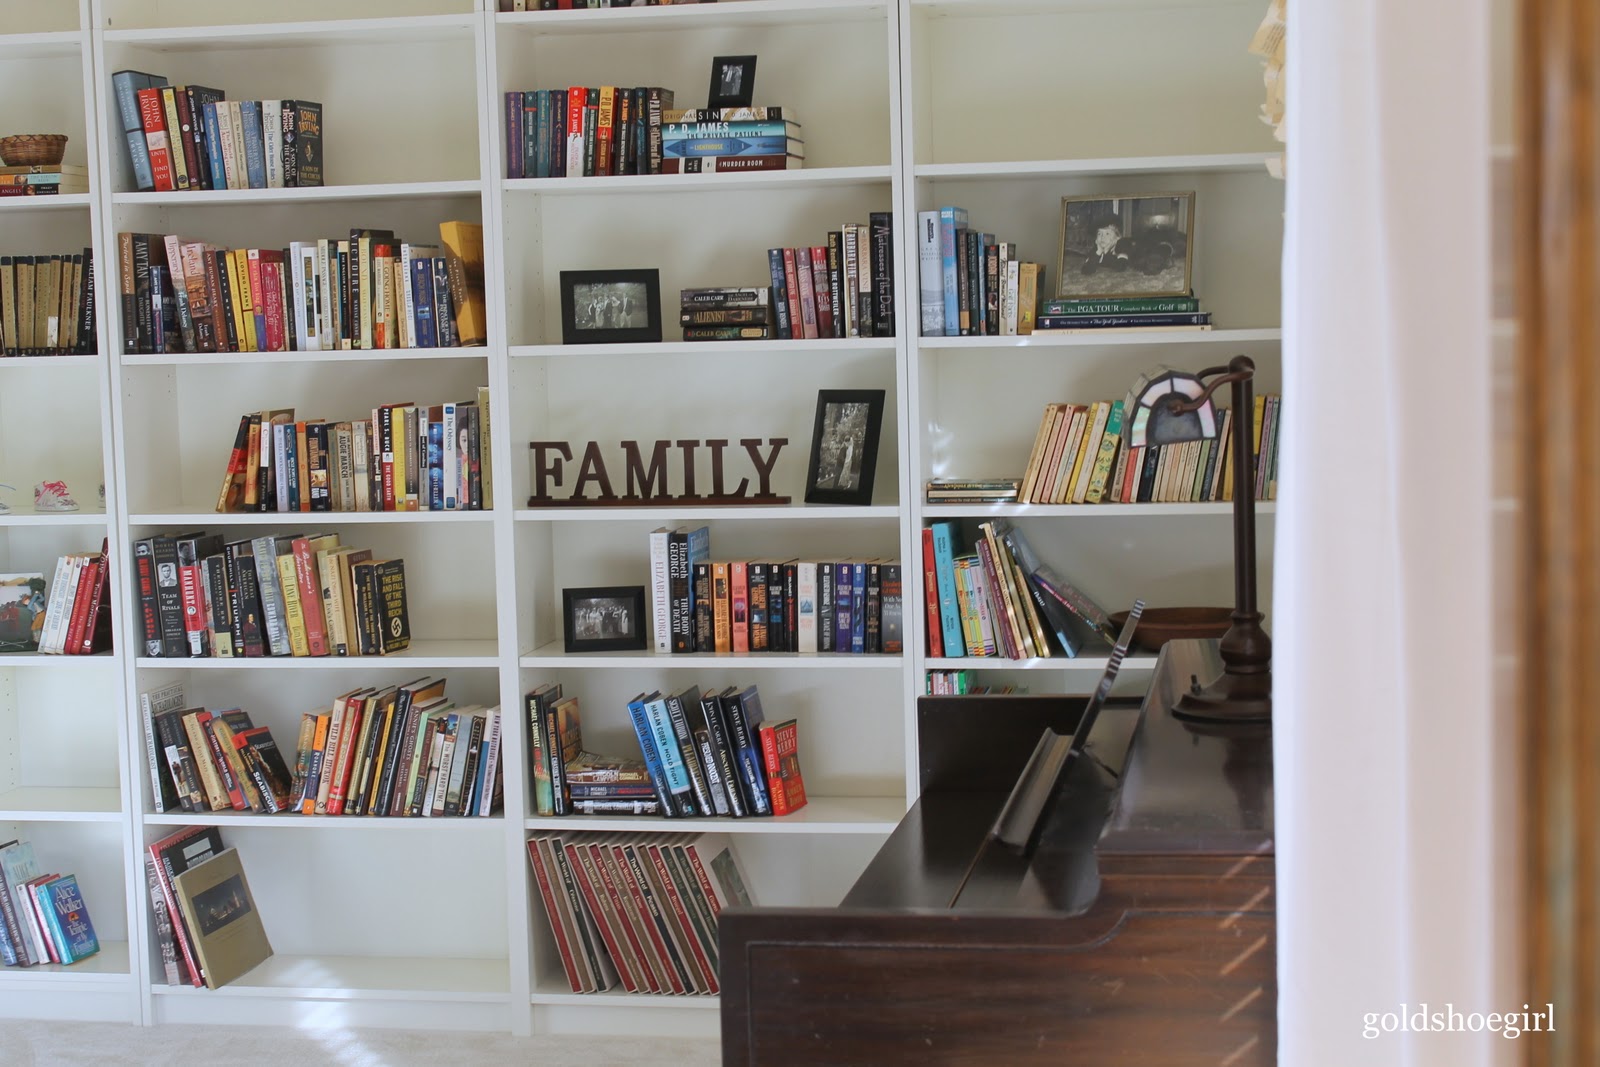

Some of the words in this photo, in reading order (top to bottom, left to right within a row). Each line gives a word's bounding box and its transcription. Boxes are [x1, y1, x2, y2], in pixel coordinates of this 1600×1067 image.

[140, 94, 153, 128] IRVING
[149, 96, 161, 123] JOHN
[300, 110, 317, 122] JOHN
[698, 112, 720, 120] SIN
[696, 122, 729, 133] JAMES
[135, 240, 147, 258] AMY
[846, 233, 856, 261] BARBARA
[874, 225, 892, 272] Mistresses
[136, 260, 148, 279] TAN
[186, 245, 200, 276] Ireland
[350, 234, 359, 294] VICTOIRE
[239, 261, 247, 285] LOVING
[382, 266, 391, 290] GOING
[847, 263, 856, 279] VINE
[875, 272, 889, 281] of
[879, 281, 888, 294] the
[832, 282, 840, 316] ROTTWEILER
[879, 295, 892, 317] Dark
[1077, 305, 1094, 313] PGA
[1094, 304, 1120, 312] TOUR
[1158, 303, 1174, 311] Golf
[84, 292, 93, 331] FAULKNER
[696, 310, 725, 322] ALIENIST
[339, 435, 347, 454] AUGIE
[446, 428, 454, 451] Odyssey
[341, 455, 349, 479] MARCH
[529, 438, 789, 501] FAMILY
[669, 542, 679, 579] GEORGE
[678, 542, 688, 579] Elizabeth
[183, 569, 195, 605] MANHUNT
[215, 564, 224, 608] THEODORE
[382, 576, 392, 584] THE
[382, 585, 392, 593] AND
[655, 562, 665, 606] ELIZABETH
[93, 582, 101, 597] Toni
[226, 546, 235, 589] CHURCHILL'S
[231, 593, 241, 636] TRIUMPH
[86, 598, 97, 627] Morrison
[287, 600, 300, 619] RIVER
[388, 609, 403, 617] REICH
[680, 597, 689, 615] THIS
[656, 607, 667, 640] GEORGE
[672, 608, 681, 633] DEATH
[681, 616, 690, 636] BODY
[529, 699, 539, 722] MICHAEL
[668, 698, 681, 720] SCOTT
[410, 709, 420, 734] ANNIE'S
[730, 705, 742, 726] STEVE
[736, 726, 748, 749] BERRY
[330, 722, 340, 741] WILD
[531, 722, 541, 748] CONNELLY
[631, 707, 648, 737] HARLAN
[641, 737, 657, 763] COBEN
[776, 728, 794, 742] STEVE
[326, 741, 336, 758] BILL
[406, 735, 415, 761] GHOSTS
[649, 704, 662, 727] HARLAN
[656, 726, 669, 747] COBEN
[663, 748, 673, 766] HOLD
[669, 767, 680, 786] TIGHT
[777, 738, 796, 754] BERRY
[310, 752, 320, 778] ROANOKE
[441, 753, 450, 772] WORST
[718, 748, 734, 779] ABSOLUTE
[768, 753, 777, 770] BERRY
[322, 759, 333, 785] HICKOK
[439, 773, 447, 787] HARD
[252, 771, 276, 813] SEABISCUIT
[436, 788, 445, 803] TIME
[556, 851, 565, 863] The
[583, 857, 592, 868] The
[595, 857, 604, 868] The
[606, 859, 615, 870] The
[617, 857, 626, 868] The
[629, 857, 638, 868] The
[655, 858, 664, 869] The
[692, 858, 701, 868] The
[559, 862, 570, 879] World
[587, 867, 598, 883] World
[599, 867, 611, 884] World
[610, 868, 621, 884] World
[621, 867, 633, 883] World
[632, 866, 645, 885] World
[659, 868, 670, 885] World
[696, 867, 708, 883] World
[565, 877, 572, 885] of
[593, 881, 601, 889] of
[606, 882, 614, 890] of
[616, 883, 624, 891] of
[628, 882, 636, 890] of
[640, 883, 648, 891] of
[665, 883, 674, 891] of
[703, 881, 711, 890] of
[645, 895, 660, 917] Picasso
